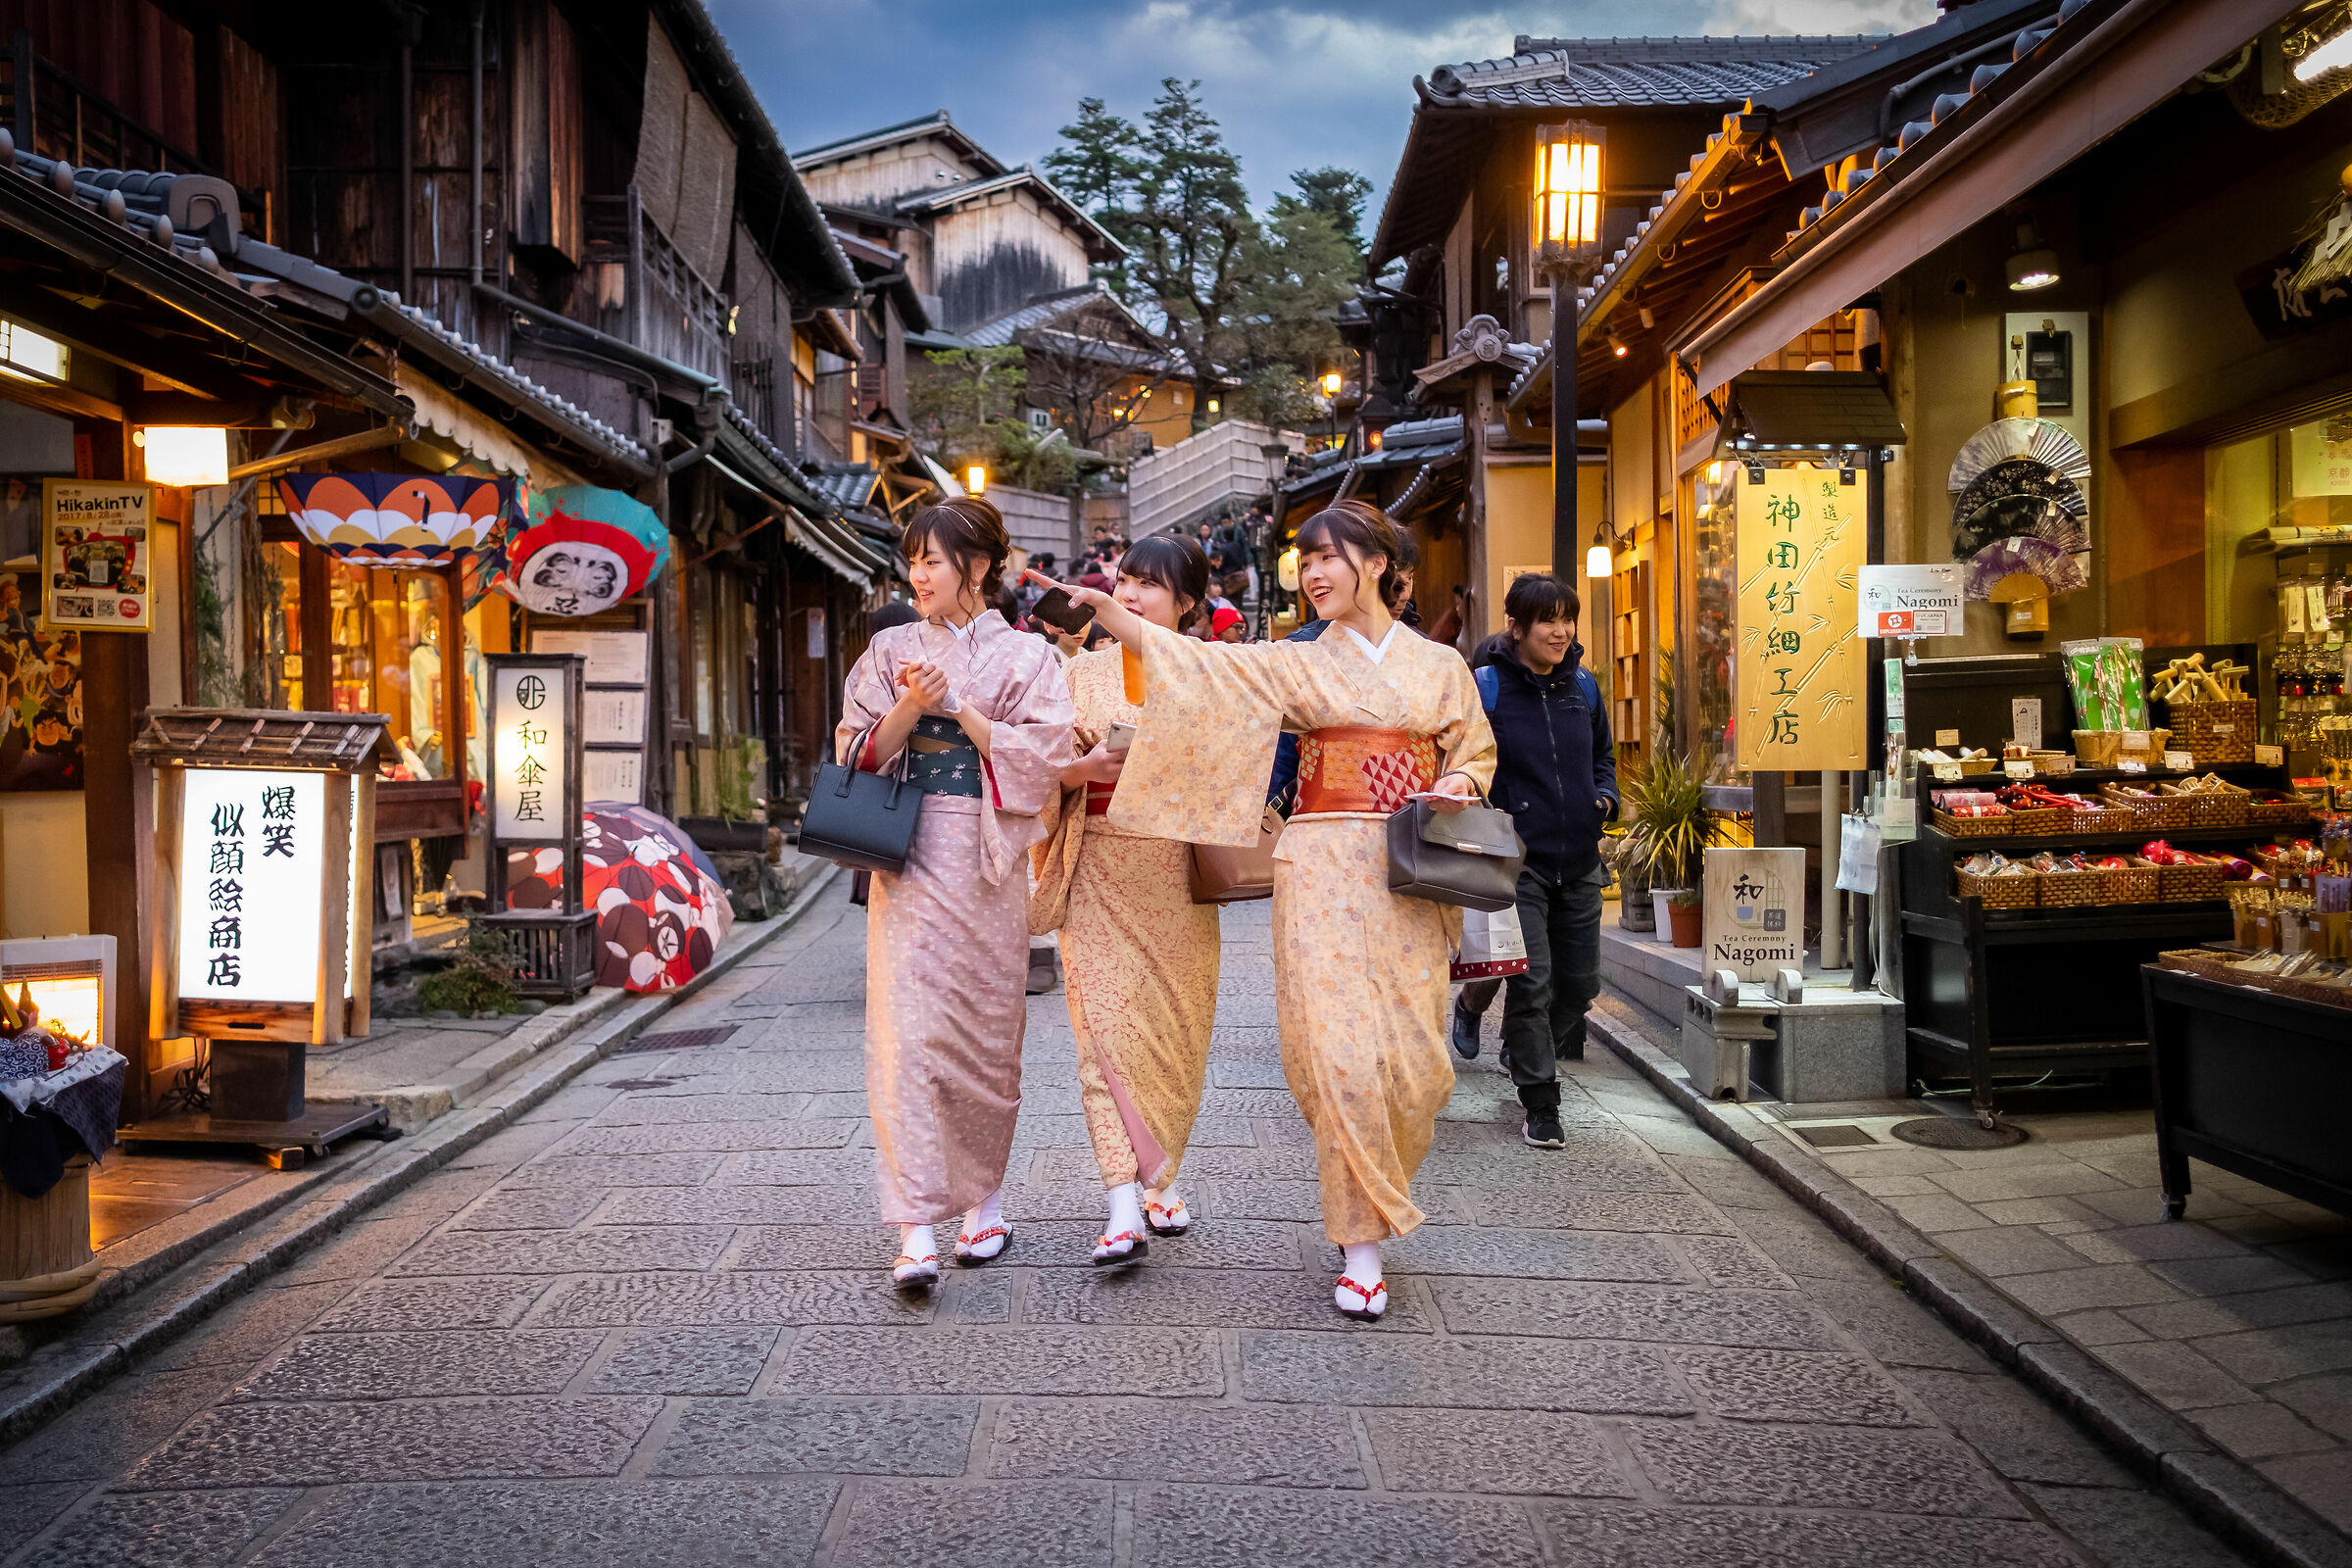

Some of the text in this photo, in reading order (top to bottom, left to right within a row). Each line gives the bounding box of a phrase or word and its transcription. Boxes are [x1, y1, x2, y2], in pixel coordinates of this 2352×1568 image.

[57, 496, 143, 512] HikakinTV
[1822, 481, 1839, 541] 製造元
[1765, 494, 1801, 745] 神田竹細工店
[1896, 594, 1959, 609] Nagomi
[514, 719, 548, 821] 和傘屋
[262, 786, 296, 858] 爆笑
[207, 803, 245, 987] 似顔絵商店
[1733, 874, 1764, 905] 和
[1713, 943, 1795, 966] Nagomi
